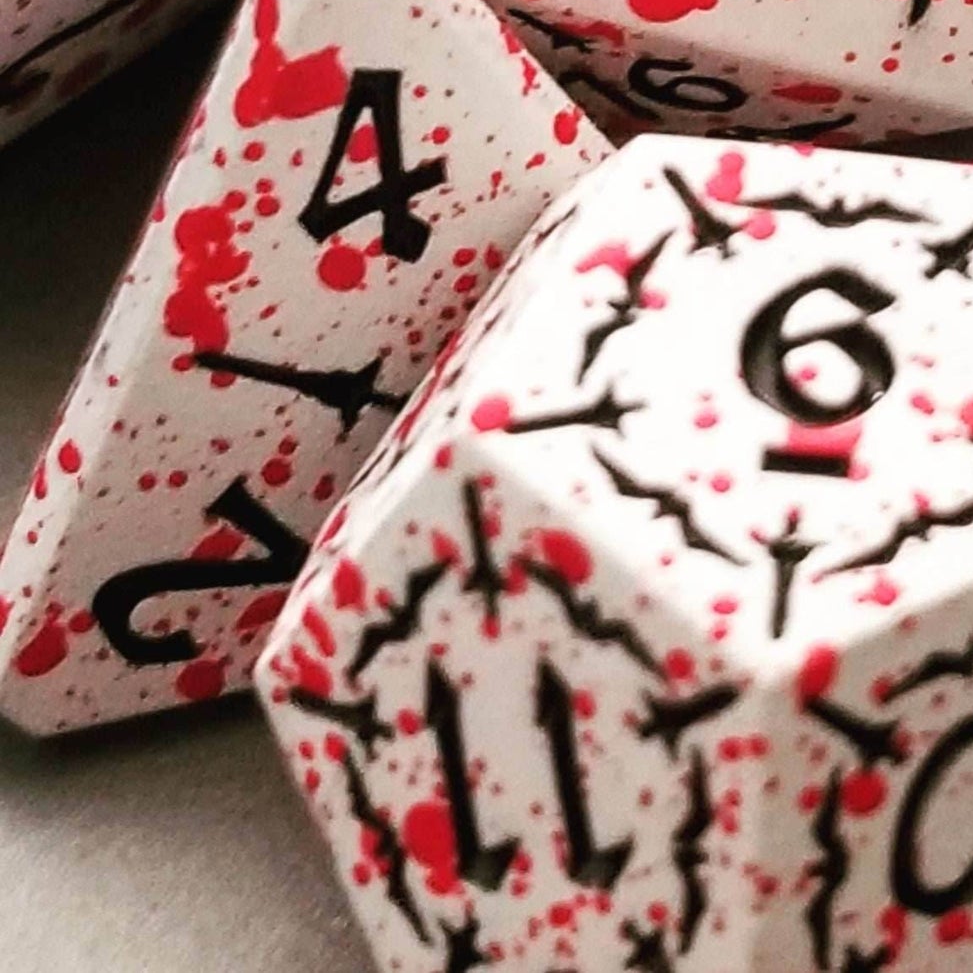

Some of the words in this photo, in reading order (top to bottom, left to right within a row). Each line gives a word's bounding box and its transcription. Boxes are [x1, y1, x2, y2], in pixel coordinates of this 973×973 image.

[298, 70, 447, 263] 4
[740, 268, 896, 424] 6
[91, 475, 314, 666] 2
[425, 661, 635, 891] 11
